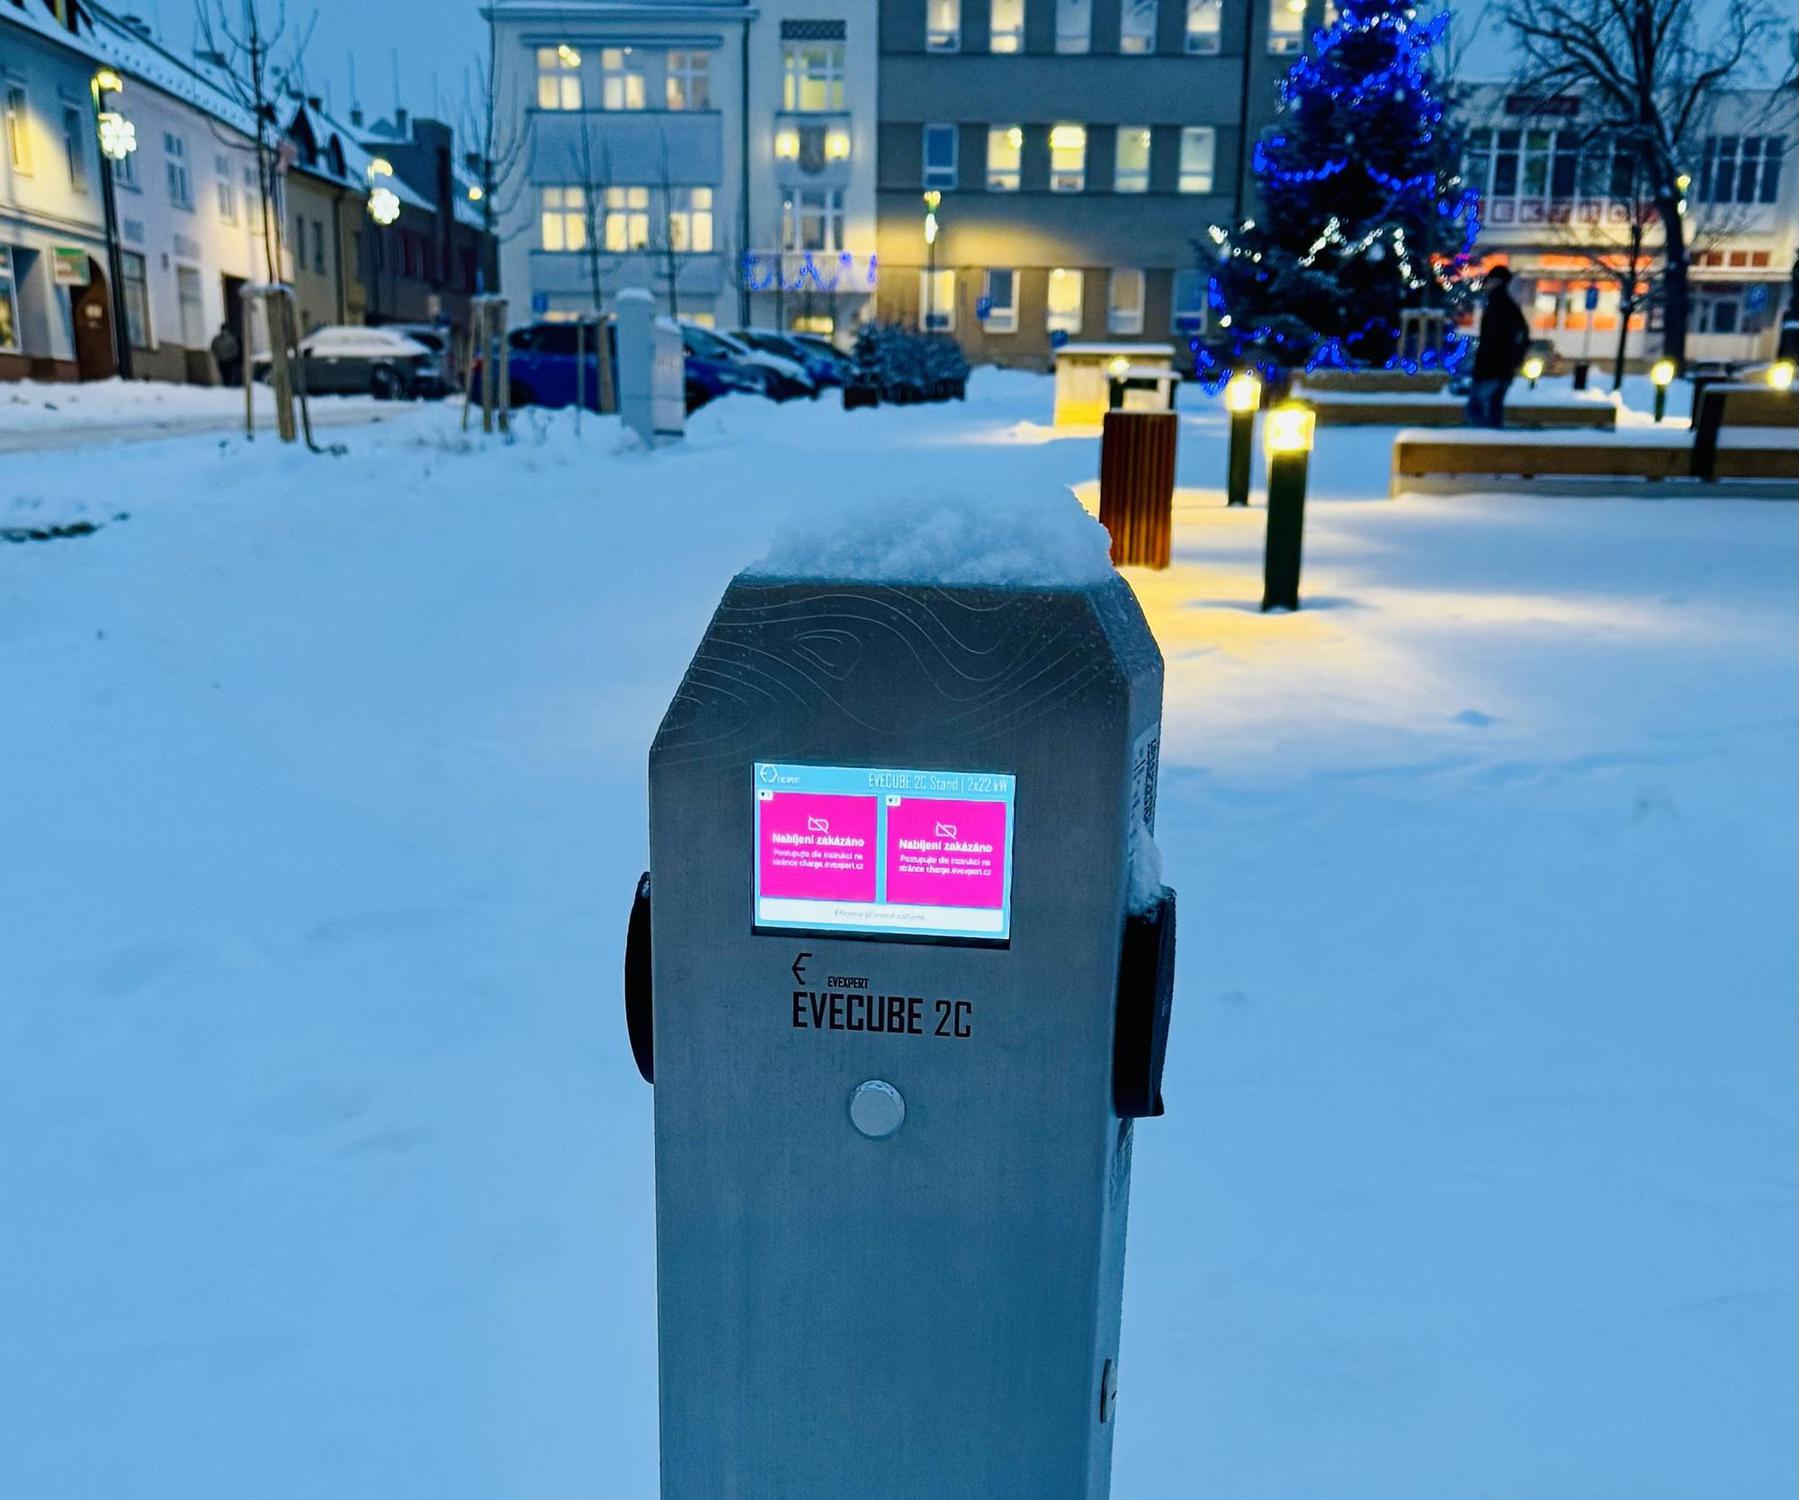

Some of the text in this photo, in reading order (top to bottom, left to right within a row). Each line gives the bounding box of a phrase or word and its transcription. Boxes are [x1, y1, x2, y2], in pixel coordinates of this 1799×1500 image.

[868, 773, 911, 789] EVECUBE
[914, 775, 927, 790] 2C
[930, 775, 958, 791] Stand
[967, 777, 992, 793] 2x22
[993, 778, 1008, 793] kW
[827, 976, 869, 989] EVEXPERT
[793, 991, 972, 1037] EVECUBE 2C
